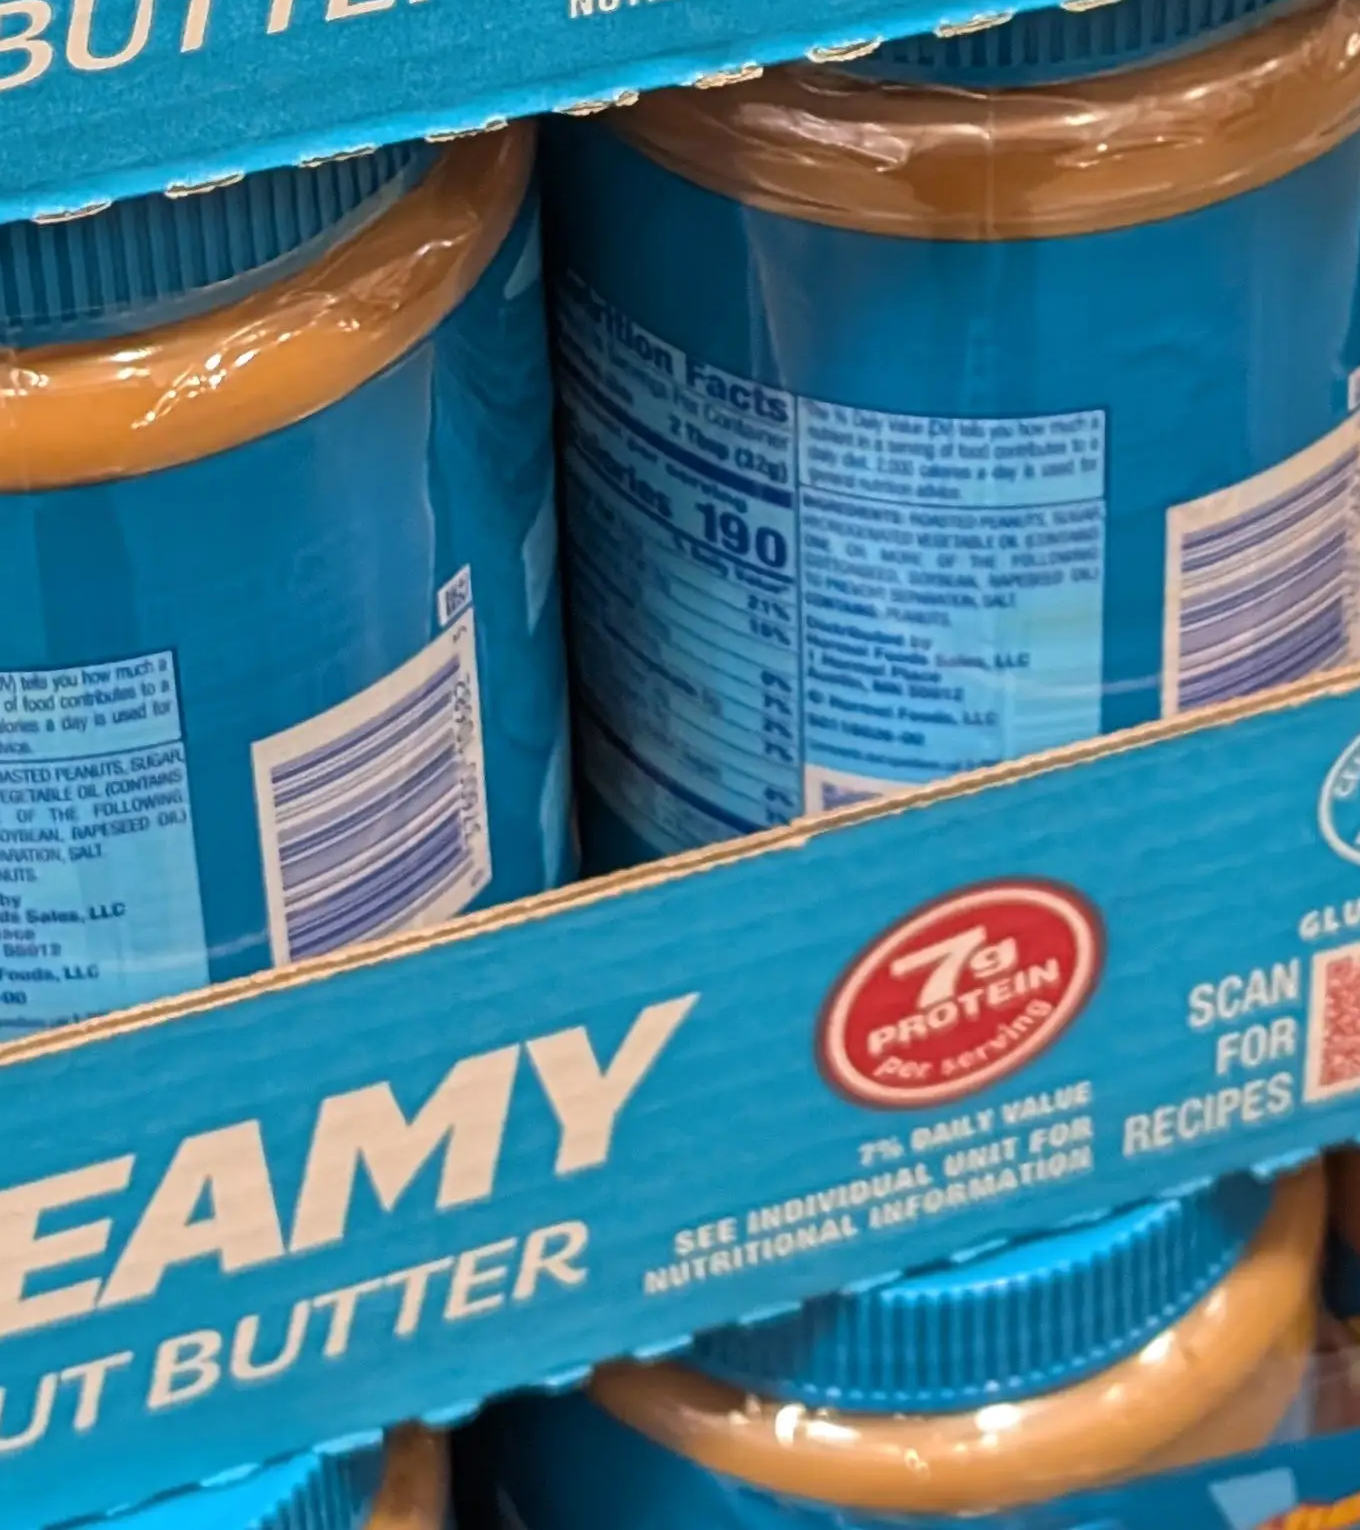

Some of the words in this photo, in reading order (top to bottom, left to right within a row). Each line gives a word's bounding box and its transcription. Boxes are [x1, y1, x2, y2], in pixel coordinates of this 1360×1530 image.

[686, 362, 789, 425] Facts
[703, 501, 789, 569] 190
[867, 957, 1060, 1056] PROTEIN
[889, 925, 1017, 1009] 7g
[1188, 958, 1300, 1028] SCAN
[872, 1055, 933, 1079] per
[940, 999, 1053, 1076] serving
[1215, 1016, 1296, 1075] FOR
[857, 1137, 904, 1167] 7%
[910, 1108, 994, 1151] DAILY
[1001, 1081, 1092, 1125] VALUE
[1123, 1071, 1293, 1158] RECIPES
[644, 1215, 859, 1294] NUTRITIONAL
[869, 1146, 1094, 1228] INFORMATION
[675, 1217, 738, 1255] SEE
[747, 1163, 933, 1235] INDIVIDUAL
[943, 1136, 1019, 1177] UNIT
[1029, 1116, 1094, 1154] FOR
[146, 1220, 589, 1411] BUTTER
